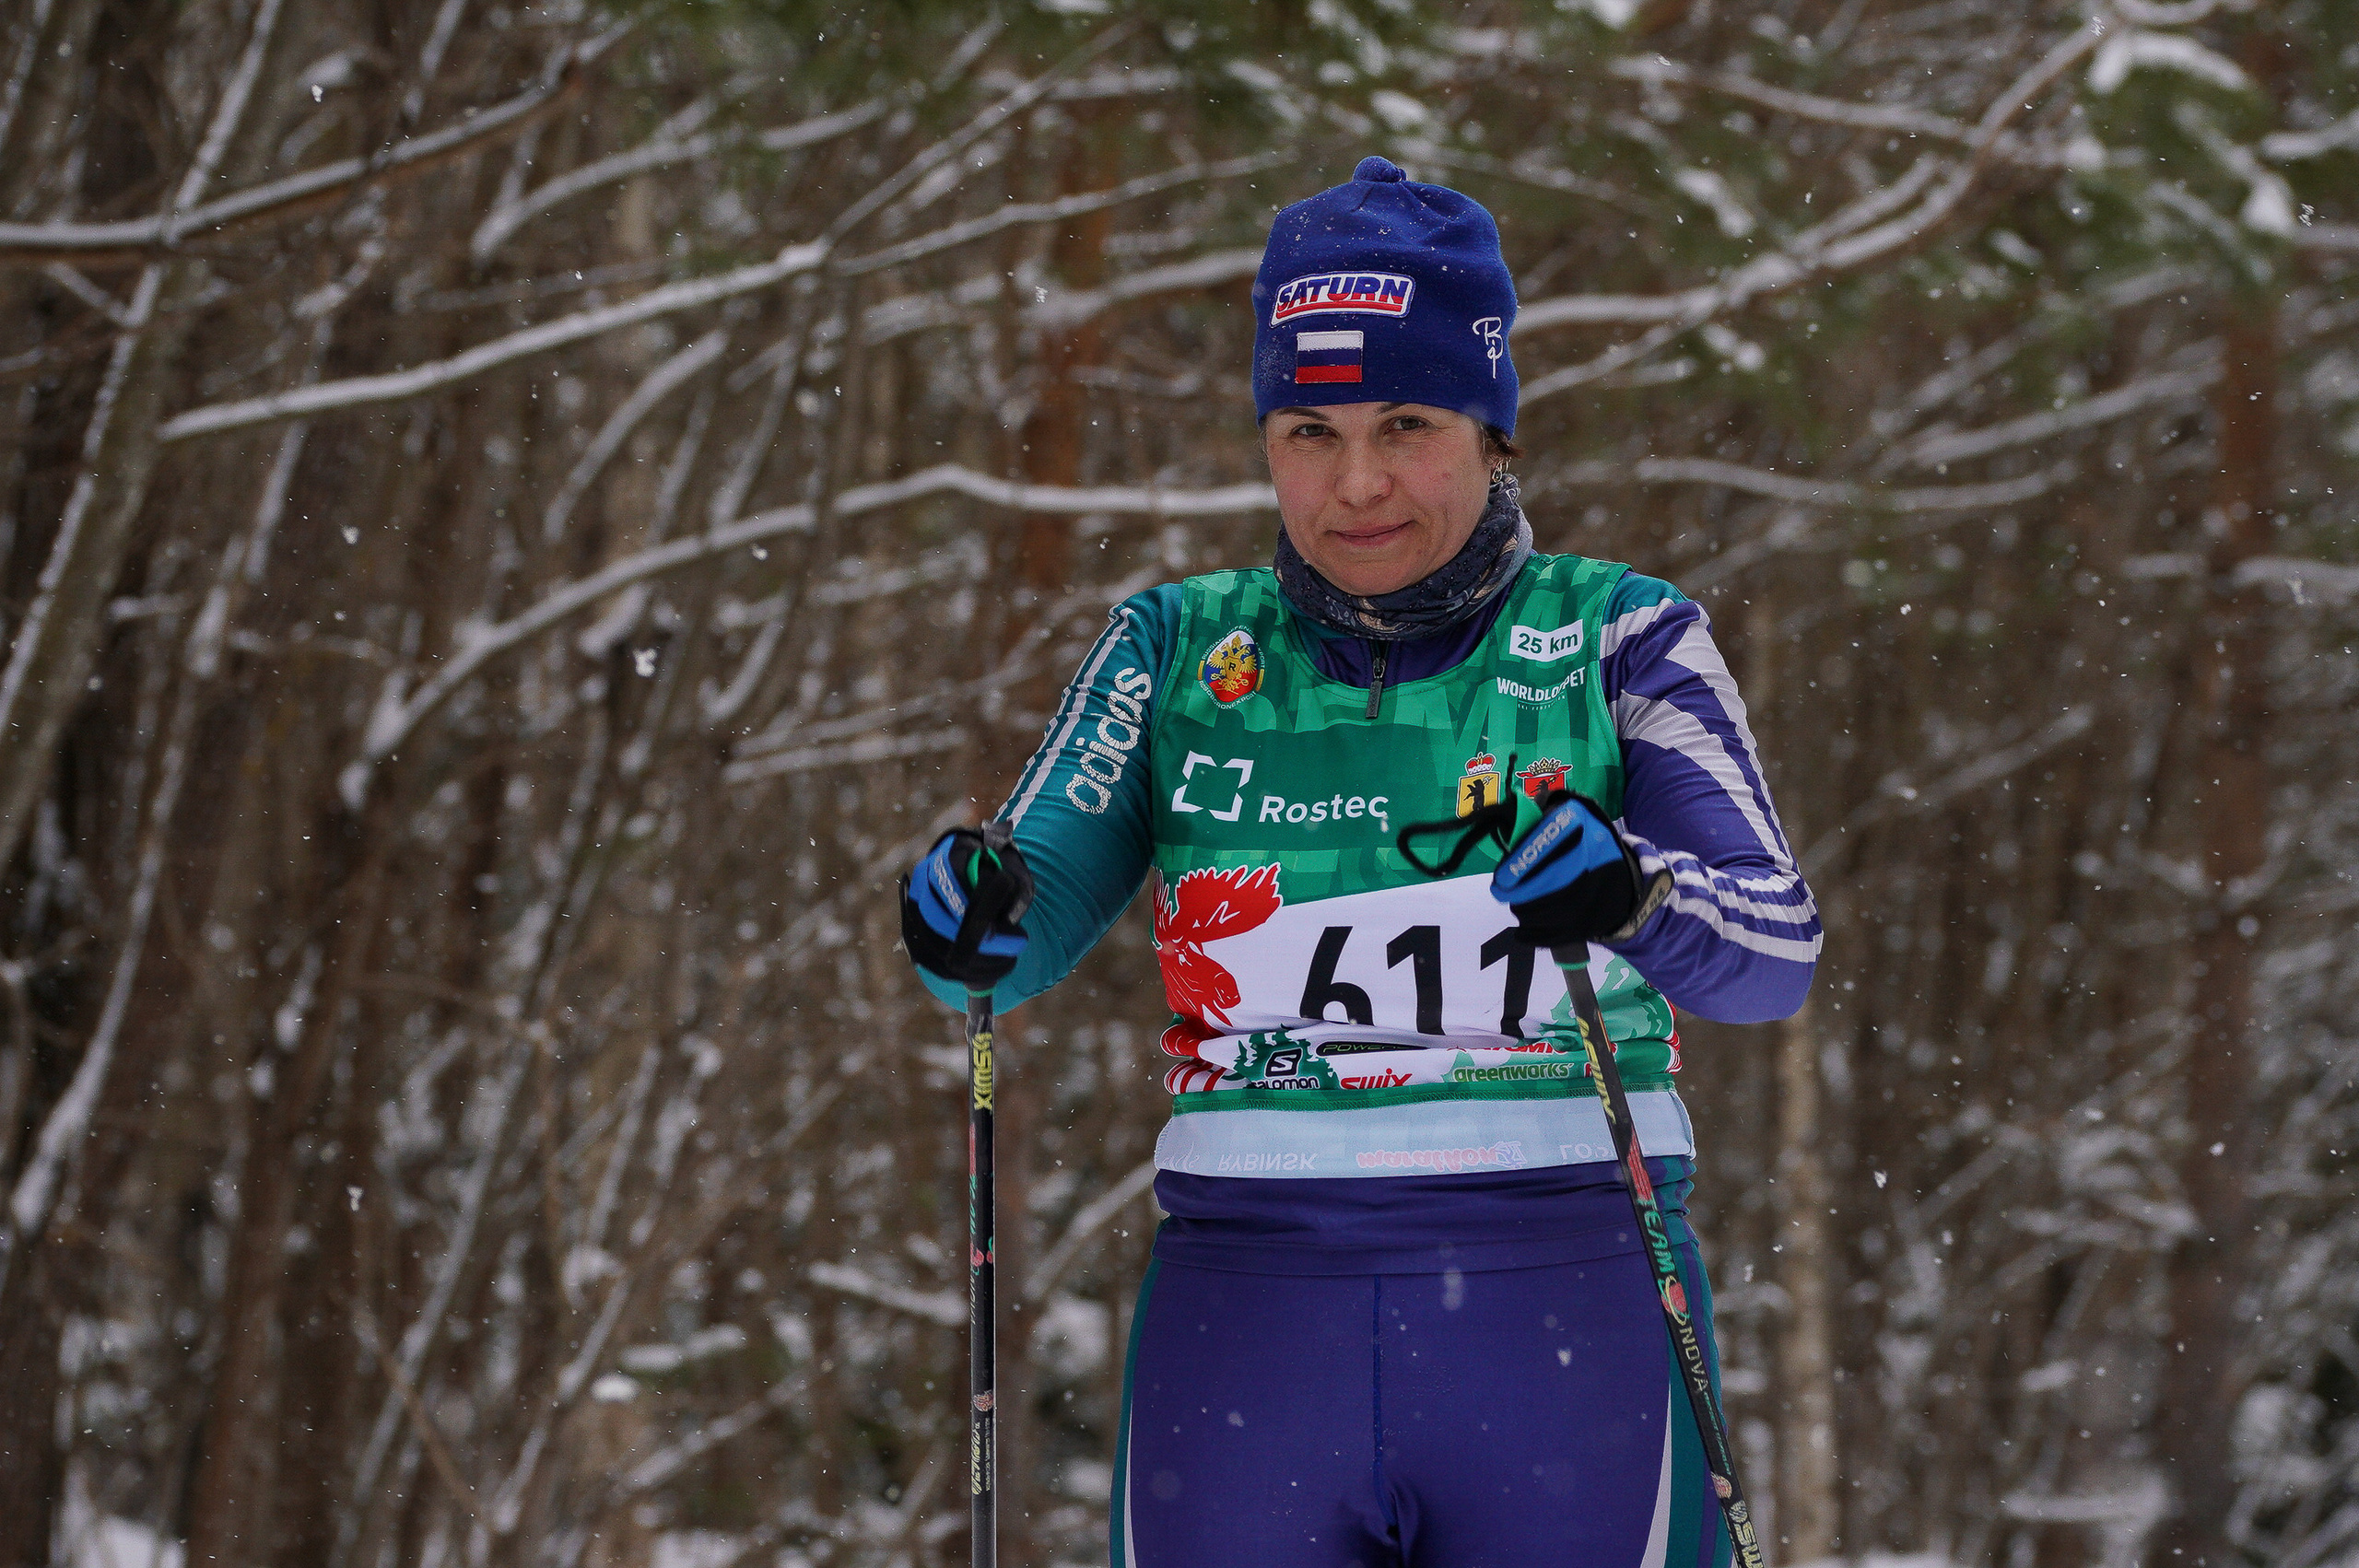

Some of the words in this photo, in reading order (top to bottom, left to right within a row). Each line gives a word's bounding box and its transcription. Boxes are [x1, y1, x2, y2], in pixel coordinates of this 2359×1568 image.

[1277, 276, 1409, 311] SATURN
[1517, 633, 1543, 654] 25
[1550, 633, 1579, 654] km
[1066, 667, 1152, 815] adidas
[1259, 794, 1389, 824] Rostec
[1299, 925, 1535, 1038] 611
